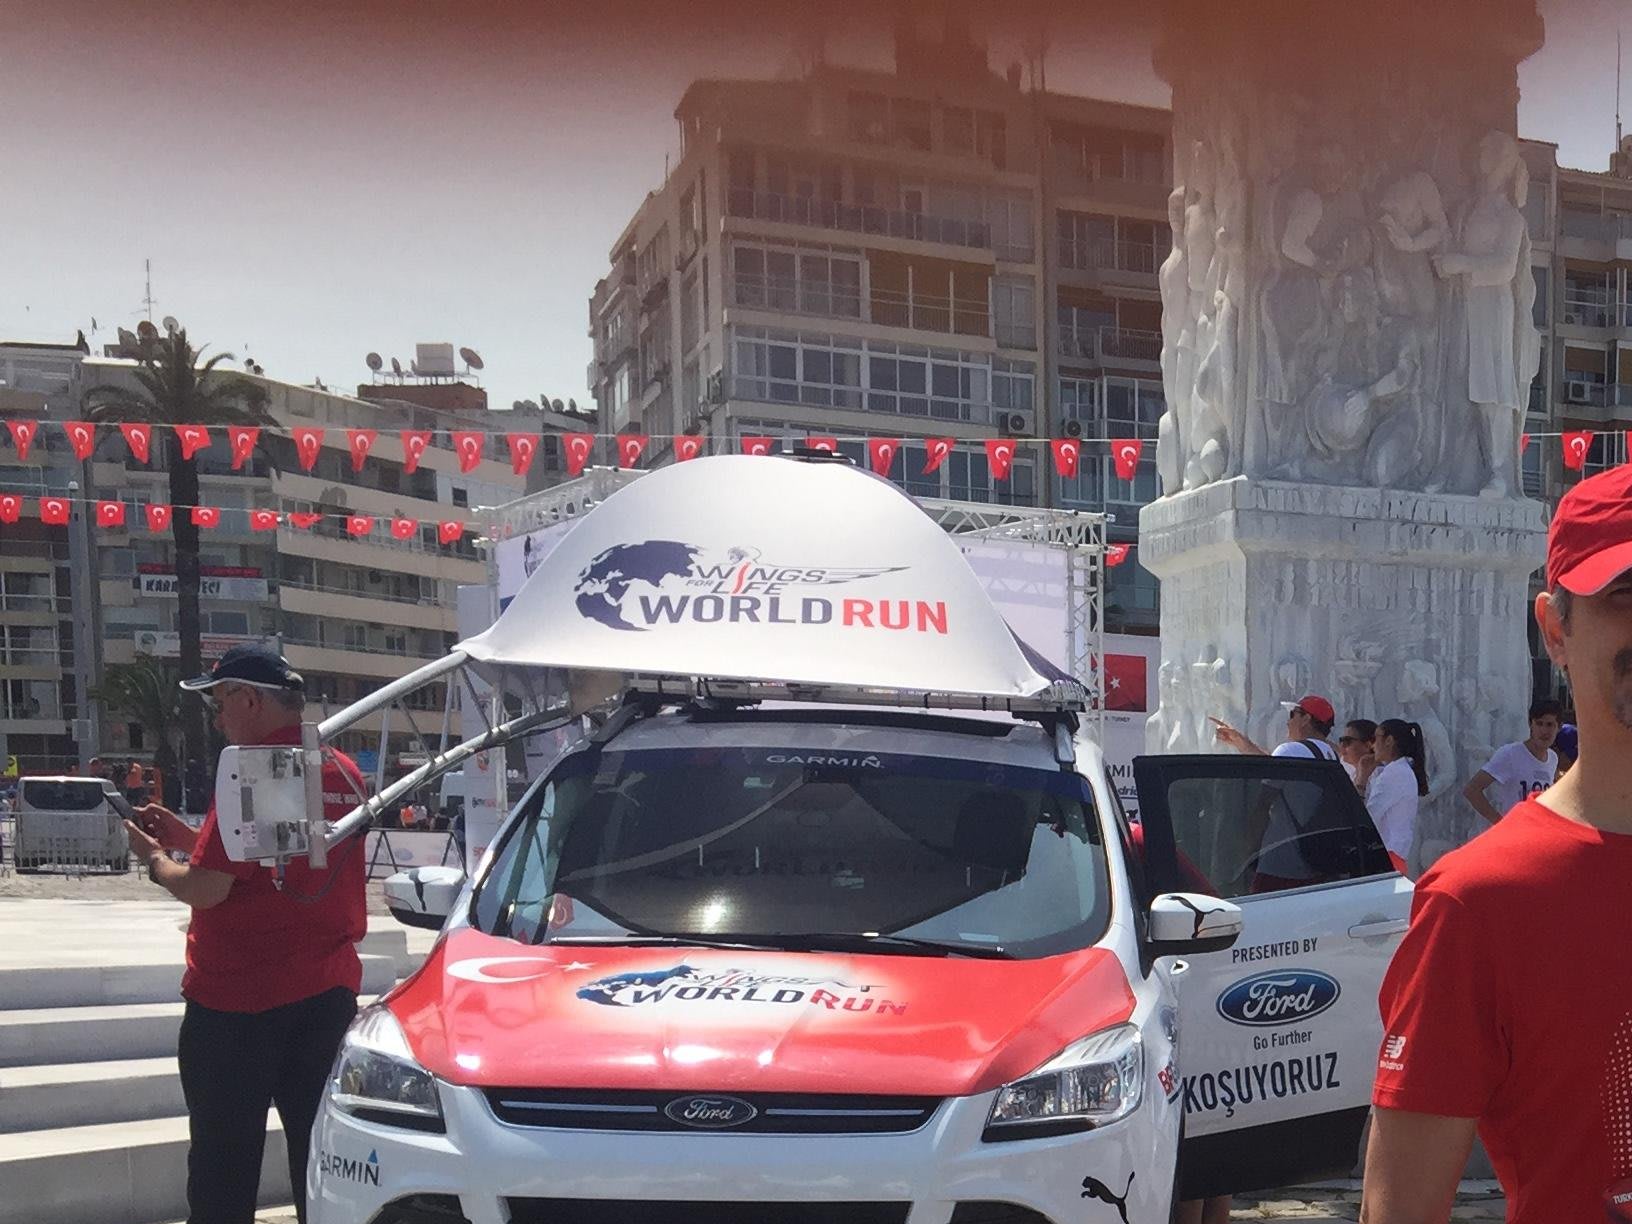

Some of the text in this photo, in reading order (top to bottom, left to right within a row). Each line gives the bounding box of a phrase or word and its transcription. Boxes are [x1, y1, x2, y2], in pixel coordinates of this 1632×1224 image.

[695, 562, 827, 583] WINGS
[685, 578, 788, 596] FOR LIFE
[639, 594, 948, 635] WORLD RUN
[766, 755, 881, 769] GARMIN
[1232, 937, 1318, 963] PRESENTED BY
[633, 984, 909, 1017] WORLD RUN
[1243, 978, 1316, 1018] Ford
[1254, 1031, 1313, 1050] Go Further
[1182, 1052, 1340, 1117] KOŞUYORUZ
[684, 1099, 735, 1120] Ford
